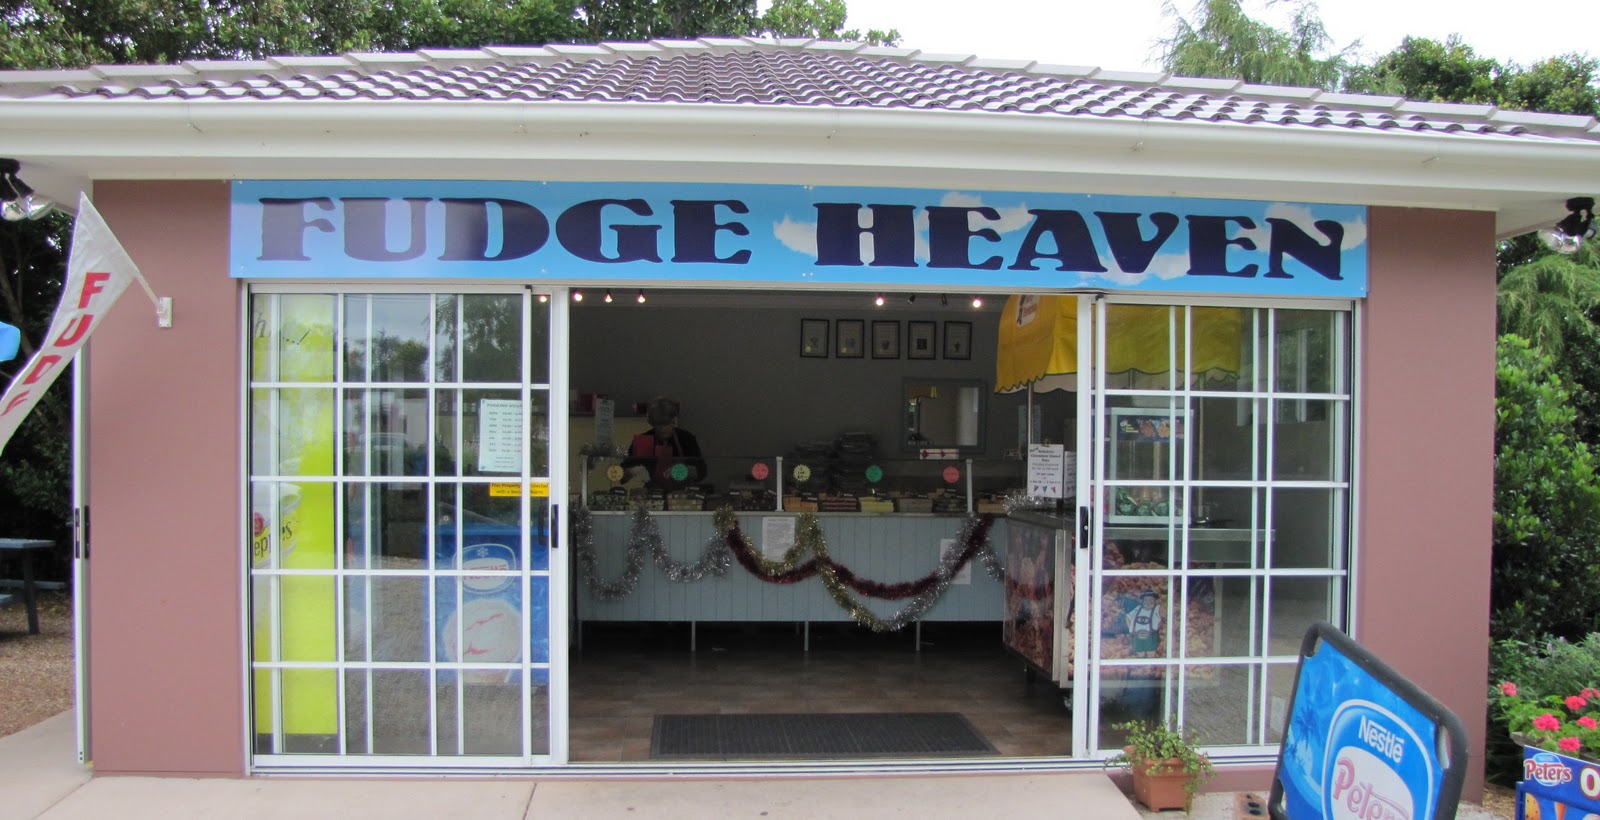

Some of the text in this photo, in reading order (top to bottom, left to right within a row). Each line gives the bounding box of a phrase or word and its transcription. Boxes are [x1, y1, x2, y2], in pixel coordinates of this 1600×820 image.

[257, 196, 1345, 281] FUDGE HEAVEN
[1523, 758, 1572, 783] Peters
